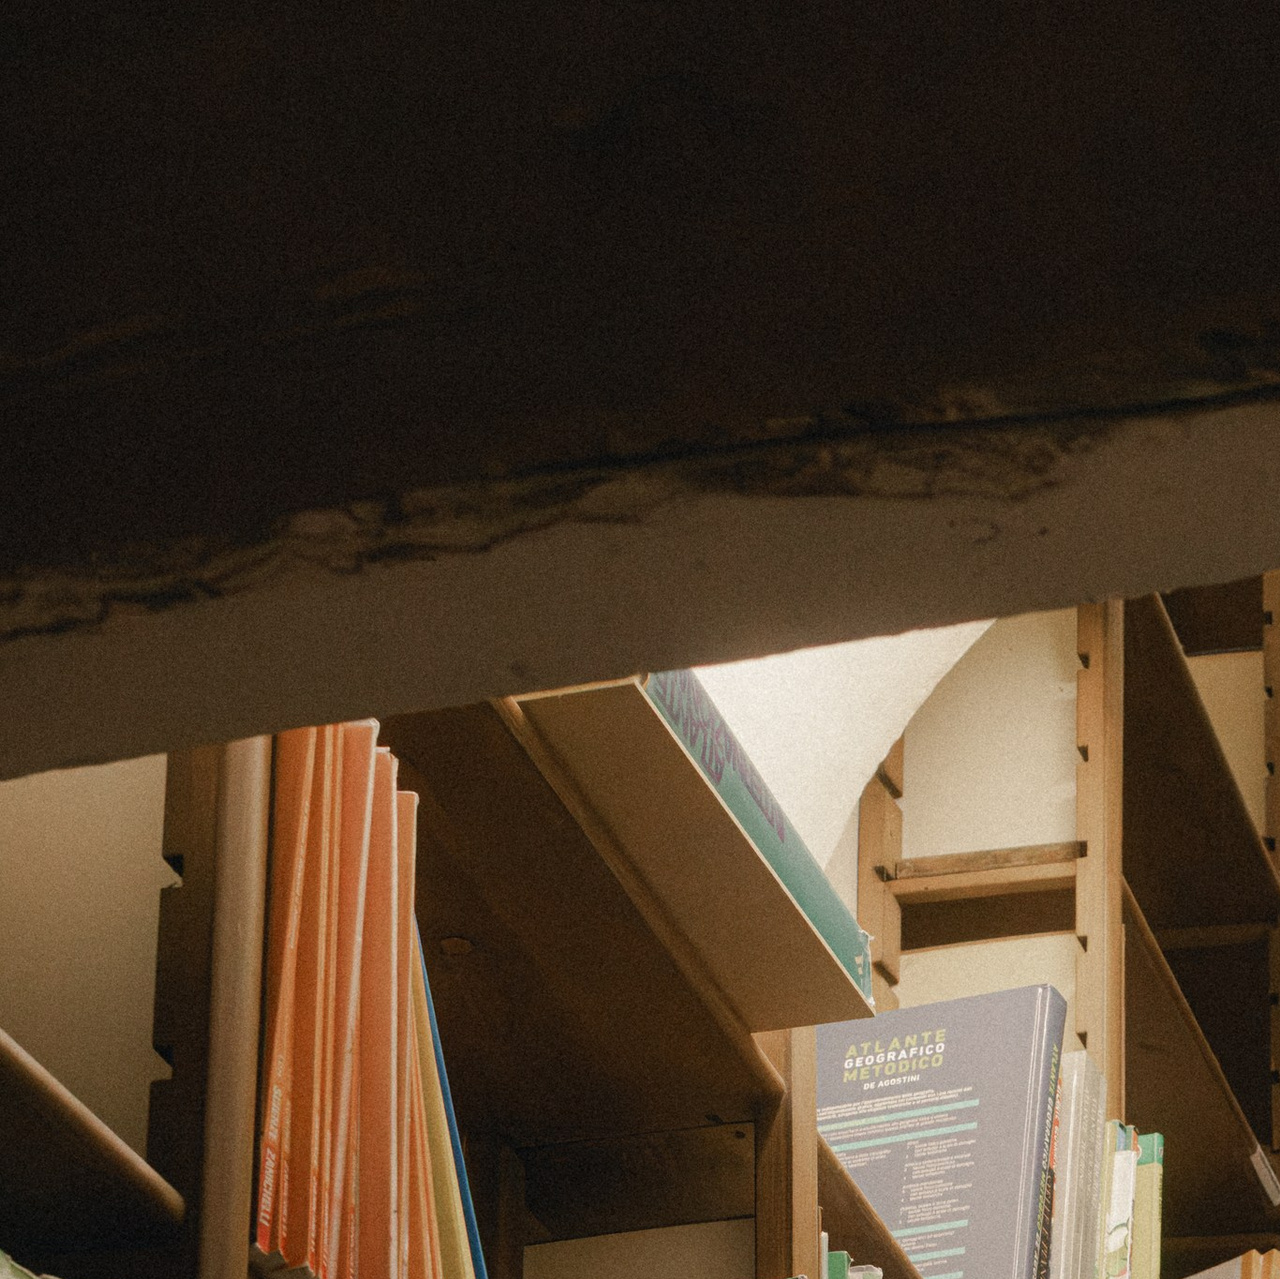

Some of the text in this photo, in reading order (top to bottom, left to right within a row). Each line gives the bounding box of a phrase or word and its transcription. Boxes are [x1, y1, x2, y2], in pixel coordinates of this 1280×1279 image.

[843, 1054, 944, 1083] METODICO
[844, 1042, 946, 1069] GEOGRAFICO
[845, 1028, 947, 1059] ATLANTE
[863, 1074, 920, 1091] DE AGOSTINI
[1049, 1043, 1059, 1096] ATLANTE
[1042, 1096, 1054, 1170] GEOGRAFICO
[259, 1147, 277, 1227] ZANICHELLI
[1036, 1170, 1047, 1231] METODICO
[1042, 1175, 1051, 1225] STELLE
